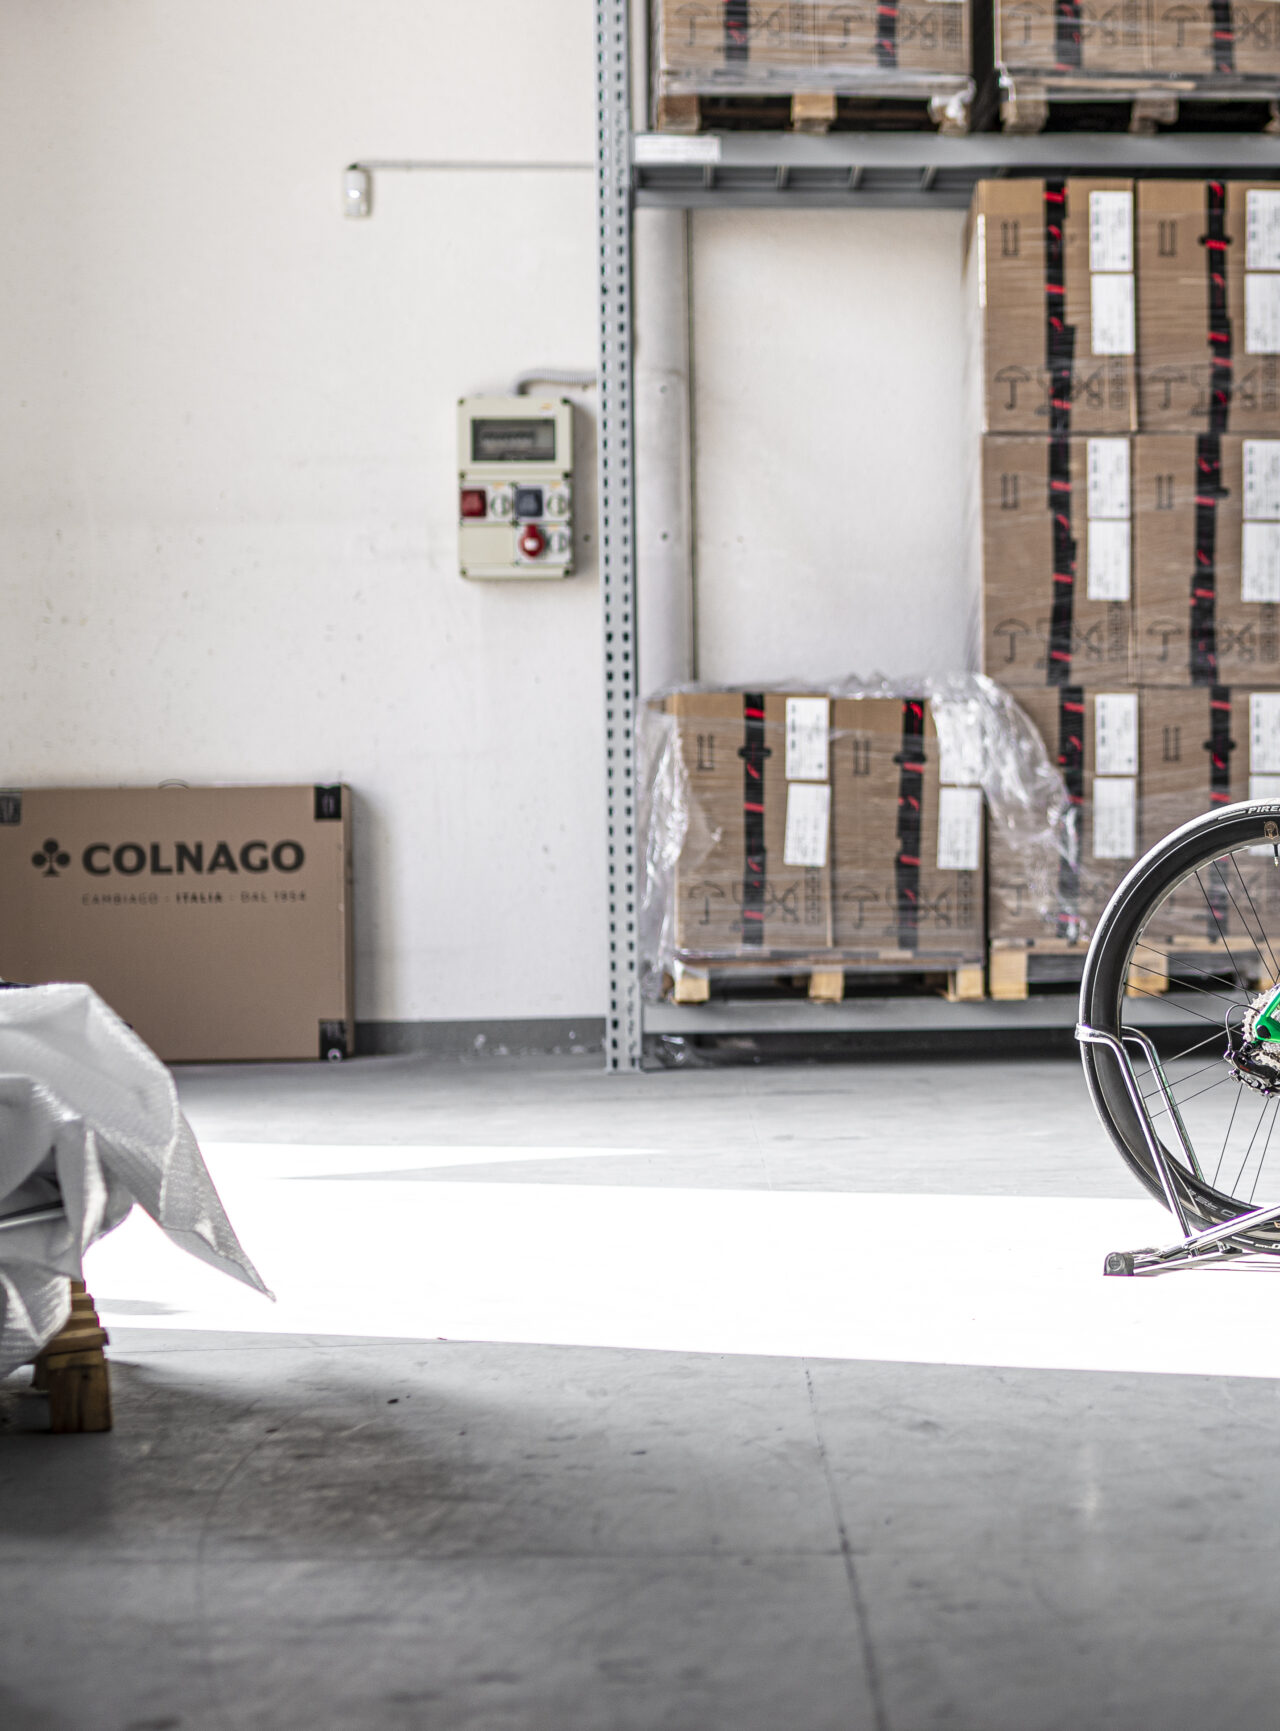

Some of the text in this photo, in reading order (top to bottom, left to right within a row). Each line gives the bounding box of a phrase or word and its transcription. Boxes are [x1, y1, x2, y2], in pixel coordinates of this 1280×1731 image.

[82, 839, 305, 876] COLNAGO
[176, 891, 223, 905] ITALIA
[240, 891, 267, 904] DAL
